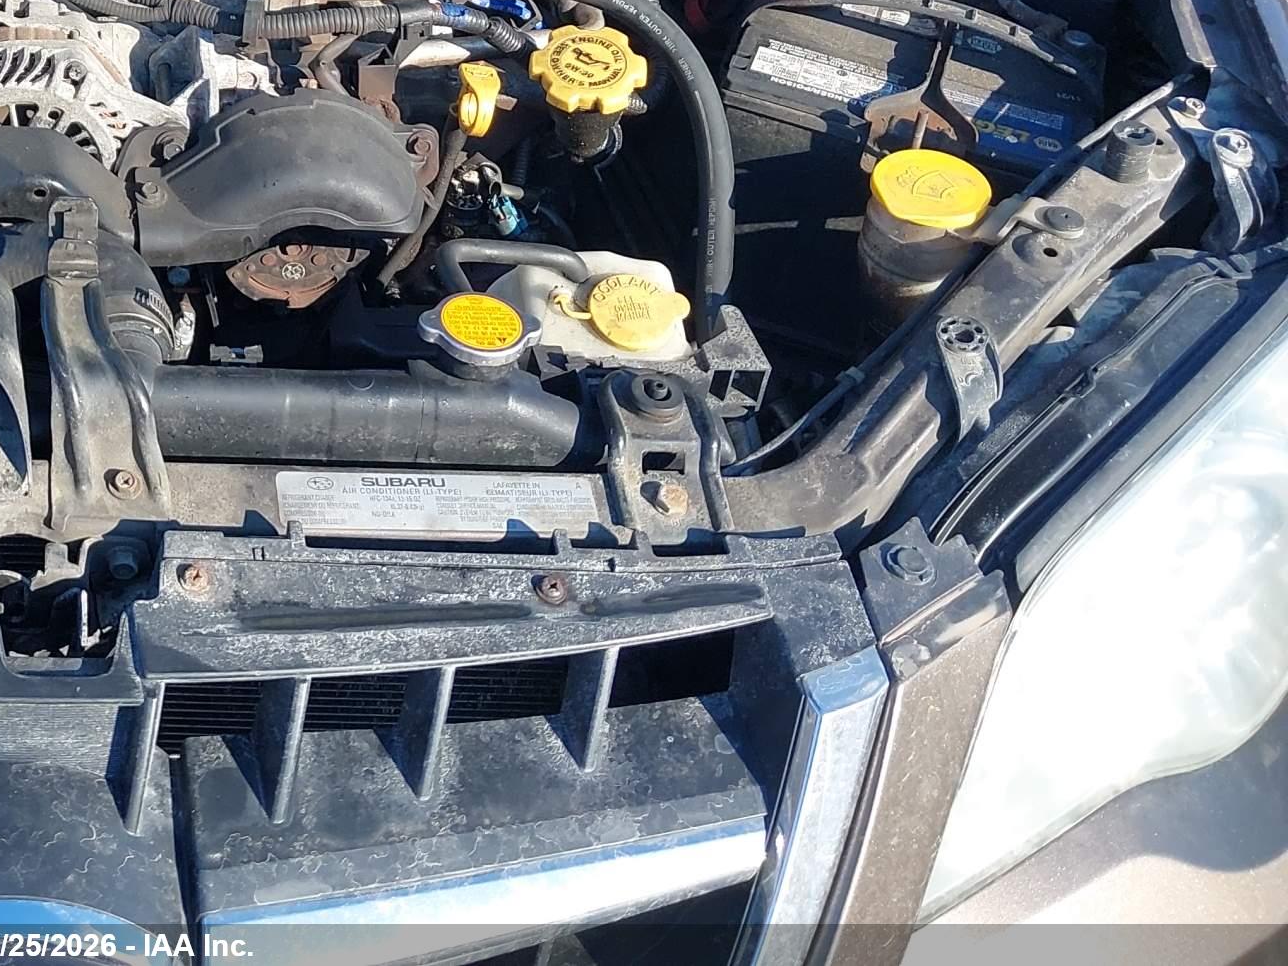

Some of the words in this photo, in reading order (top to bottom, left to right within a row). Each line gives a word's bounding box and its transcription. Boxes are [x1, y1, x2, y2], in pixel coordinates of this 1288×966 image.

[638, 12, 662, 35] OUTER
[570, 35, 614, 51] ENGINE
[611, 48, 623, 63] OIL
[592, 276, 658, 302] COOLANT
[359, 487, 421, 495] CONDITIONER
[361, 476, 446, 488] SUBARU
